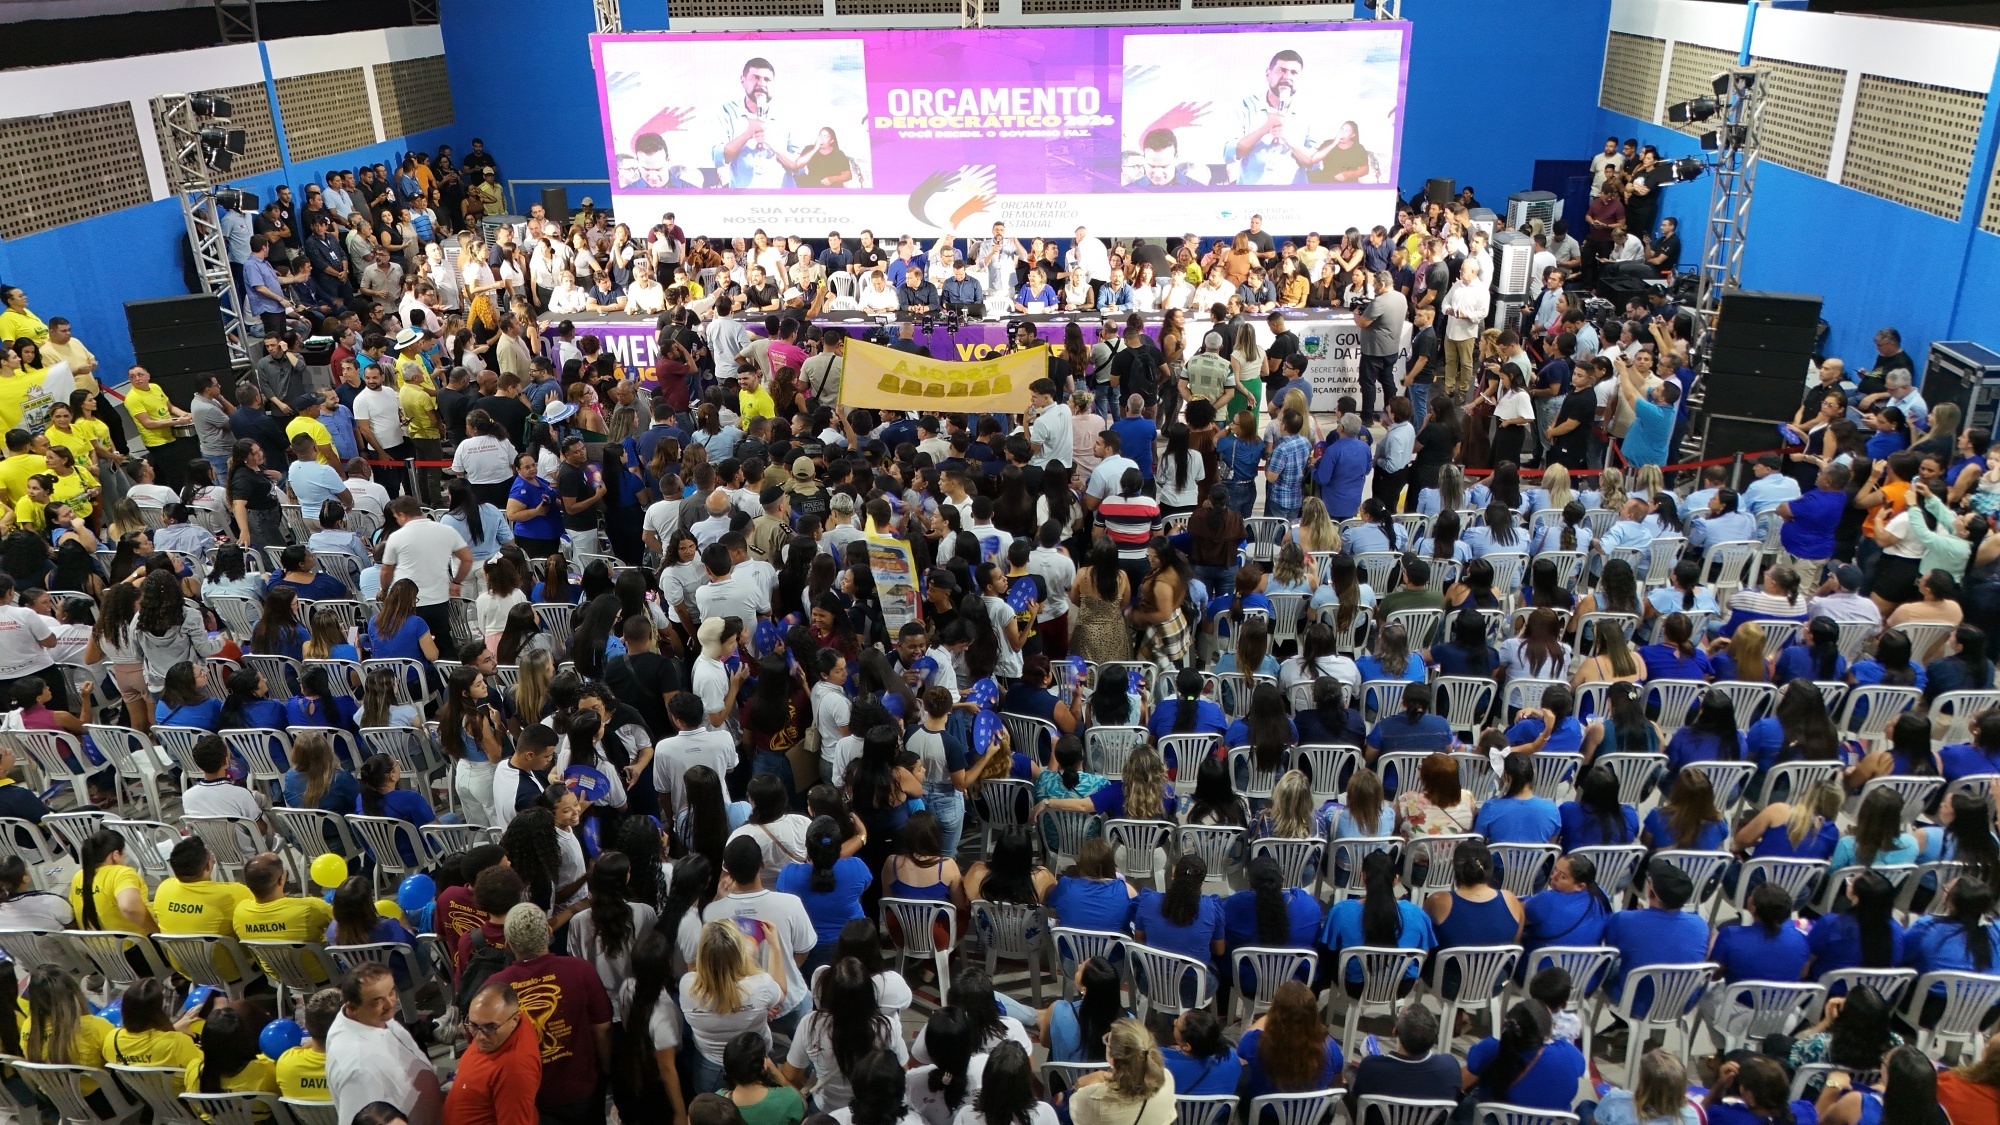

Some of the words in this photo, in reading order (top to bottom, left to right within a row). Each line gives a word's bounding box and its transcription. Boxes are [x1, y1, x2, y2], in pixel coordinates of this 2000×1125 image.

[874, 112, 1062, 129] DEMOCRÁTICO
[1063, 114, 1116, 127] 2026
[985, 129, 997, 138] O
[722, 216, 779, 224] NOSSO
[1334, 347, 1352, 360] DA
[1310, 366, 1354, 374] SECRETARIA
[1312, 387, 1358, 395] RÇAMENTO
[168, 902, 204, 914] EDSON
[245, 922, 286, 933] MARLON
